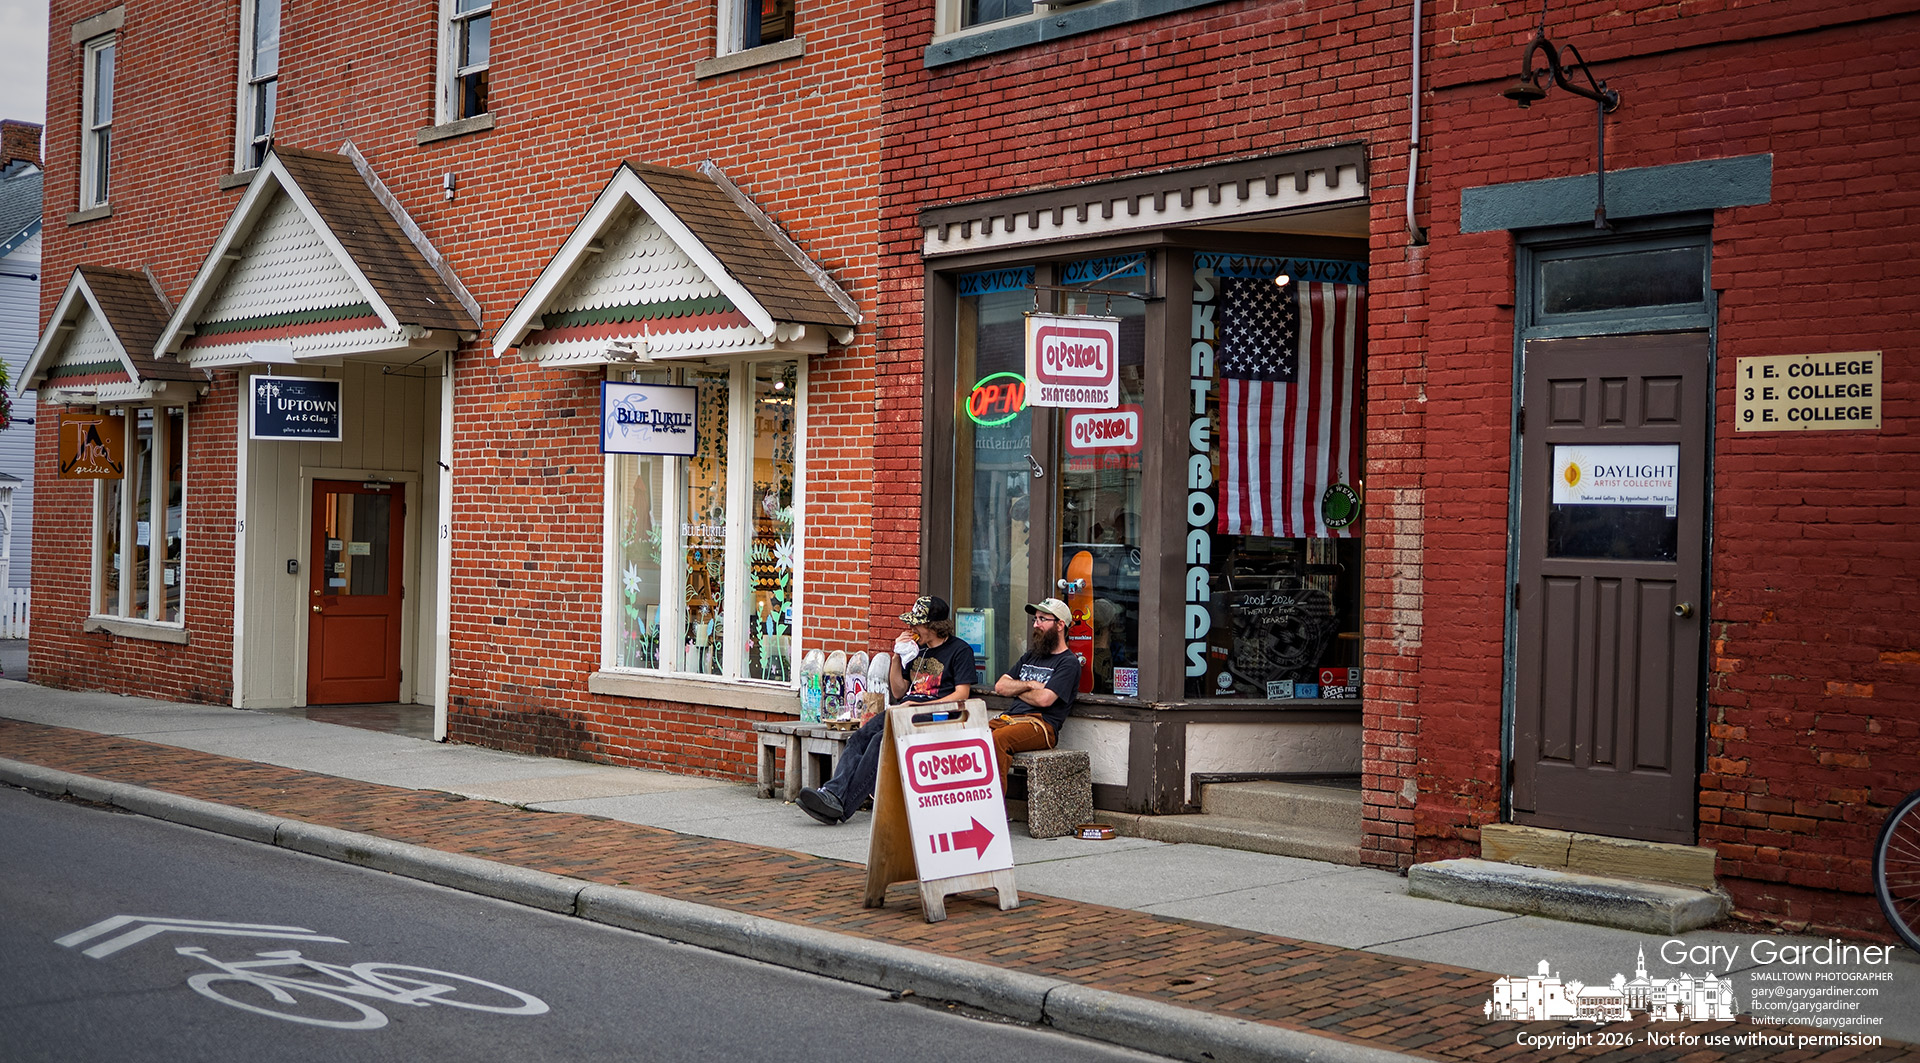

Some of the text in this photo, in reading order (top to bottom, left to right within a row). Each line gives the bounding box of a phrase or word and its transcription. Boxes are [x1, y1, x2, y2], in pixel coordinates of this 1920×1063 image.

[1243, 256, 1288, 278] VOX
[1308, 260, 1352, 282] VOX
[990, 269, 1023, 289] VOX
[1046, 341, 1104, 371] OLDSKOOL
[1745, 360, 1873, 379] 1 E. COLLEGE
[969, 382, 1026, 417] OPEN
[1041, 387, 1109, 403] SKATEBOARDS
[1743, 383, 1873, 401] 3 E. COLLEGE
[277, 397, 337, 412] UPTOWN
[285, 413, 328, 424] Art & Clay
[617, 407, 692, 427] BLUE TURTLE
[1743, 405, 1873, 423] 9 E. COLLEGE
[651, 424, 662, 432] Tea
[670, 425, 686, 434] Spice
[1075, 417, 1134, 444] OLDSKOOL
[62, 419, 114, 466] Thai
[1069, 455, 1139, 472] SKATEBOARDS
[1185, 267, 1215, 678] SKATEBOARDS
[1594, 464, 1676, 478] DAYLIGHT
[1594, 479, 1672, 487] ARTIST COLLECTIVE
[1335, 486, 1357, 504] WE'RE
[237, 520, 245, 533] 15
[682, 523, 701, 536] BLUE
[1325, 517, 1347, 526] OPEN
[440, 524, 448, 540] 13
[1243, 594, 1295, 606] 2001-2026
[1114, 674, 1138, 682] HIGHE
[919, 752, 982, 781] OLDSKOOL
[918, 788, 993, 808] SKATEBOARDS
